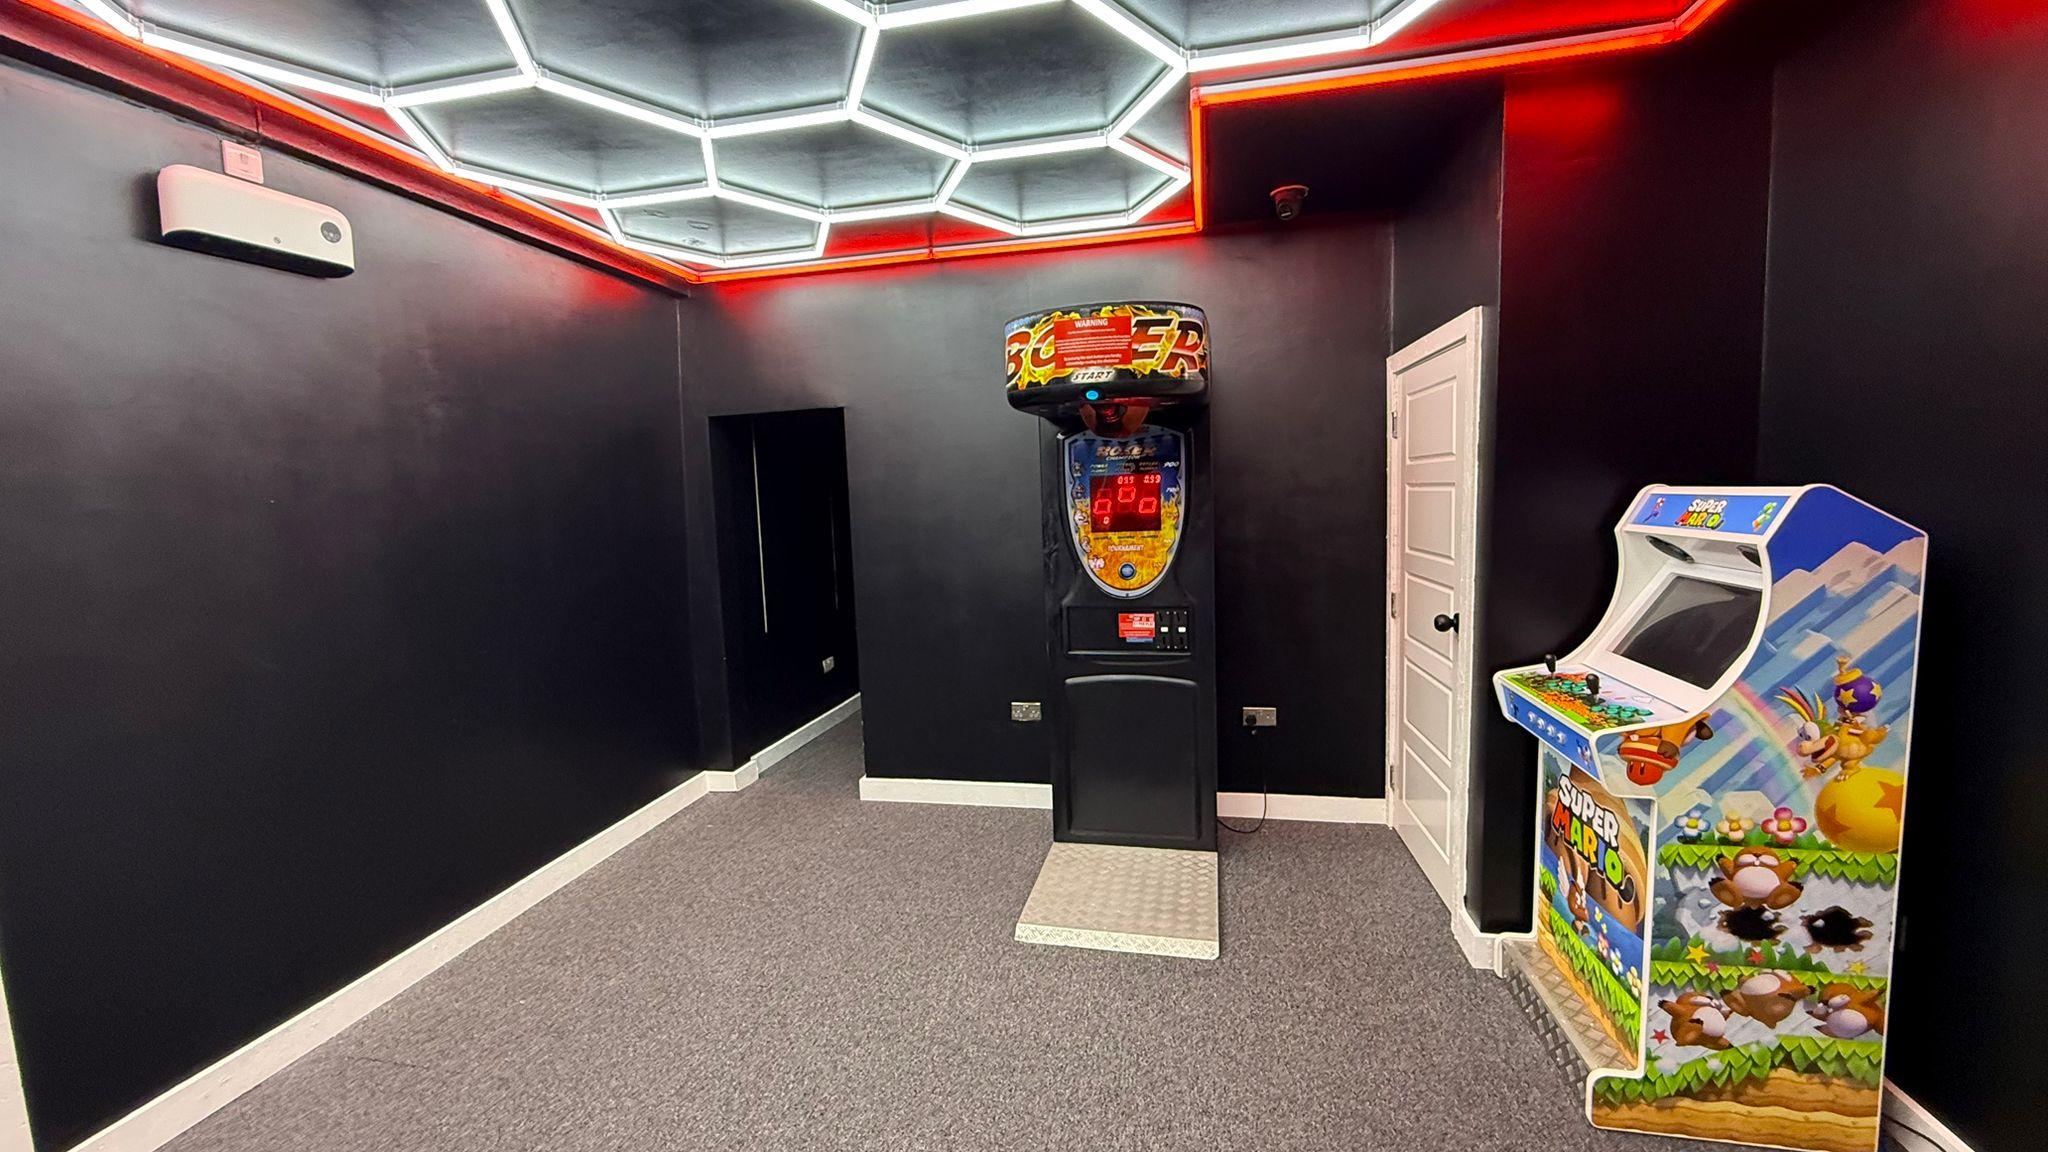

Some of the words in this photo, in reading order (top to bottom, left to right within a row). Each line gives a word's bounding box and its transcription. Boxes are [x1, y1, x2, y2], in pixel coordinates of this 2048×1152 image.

[1074, 318, 1108, 328] WARNING
[1006, 315, 1205, 387] BOER
[1072, 370, 1113, 381] START
[1689, 498, 1728, 513] SUPER
[1675, 510, 1724, 530] MARIO
[1557, 773, 1620, 847] SUPER
[1551, 799, 1624, 890] MARIO
